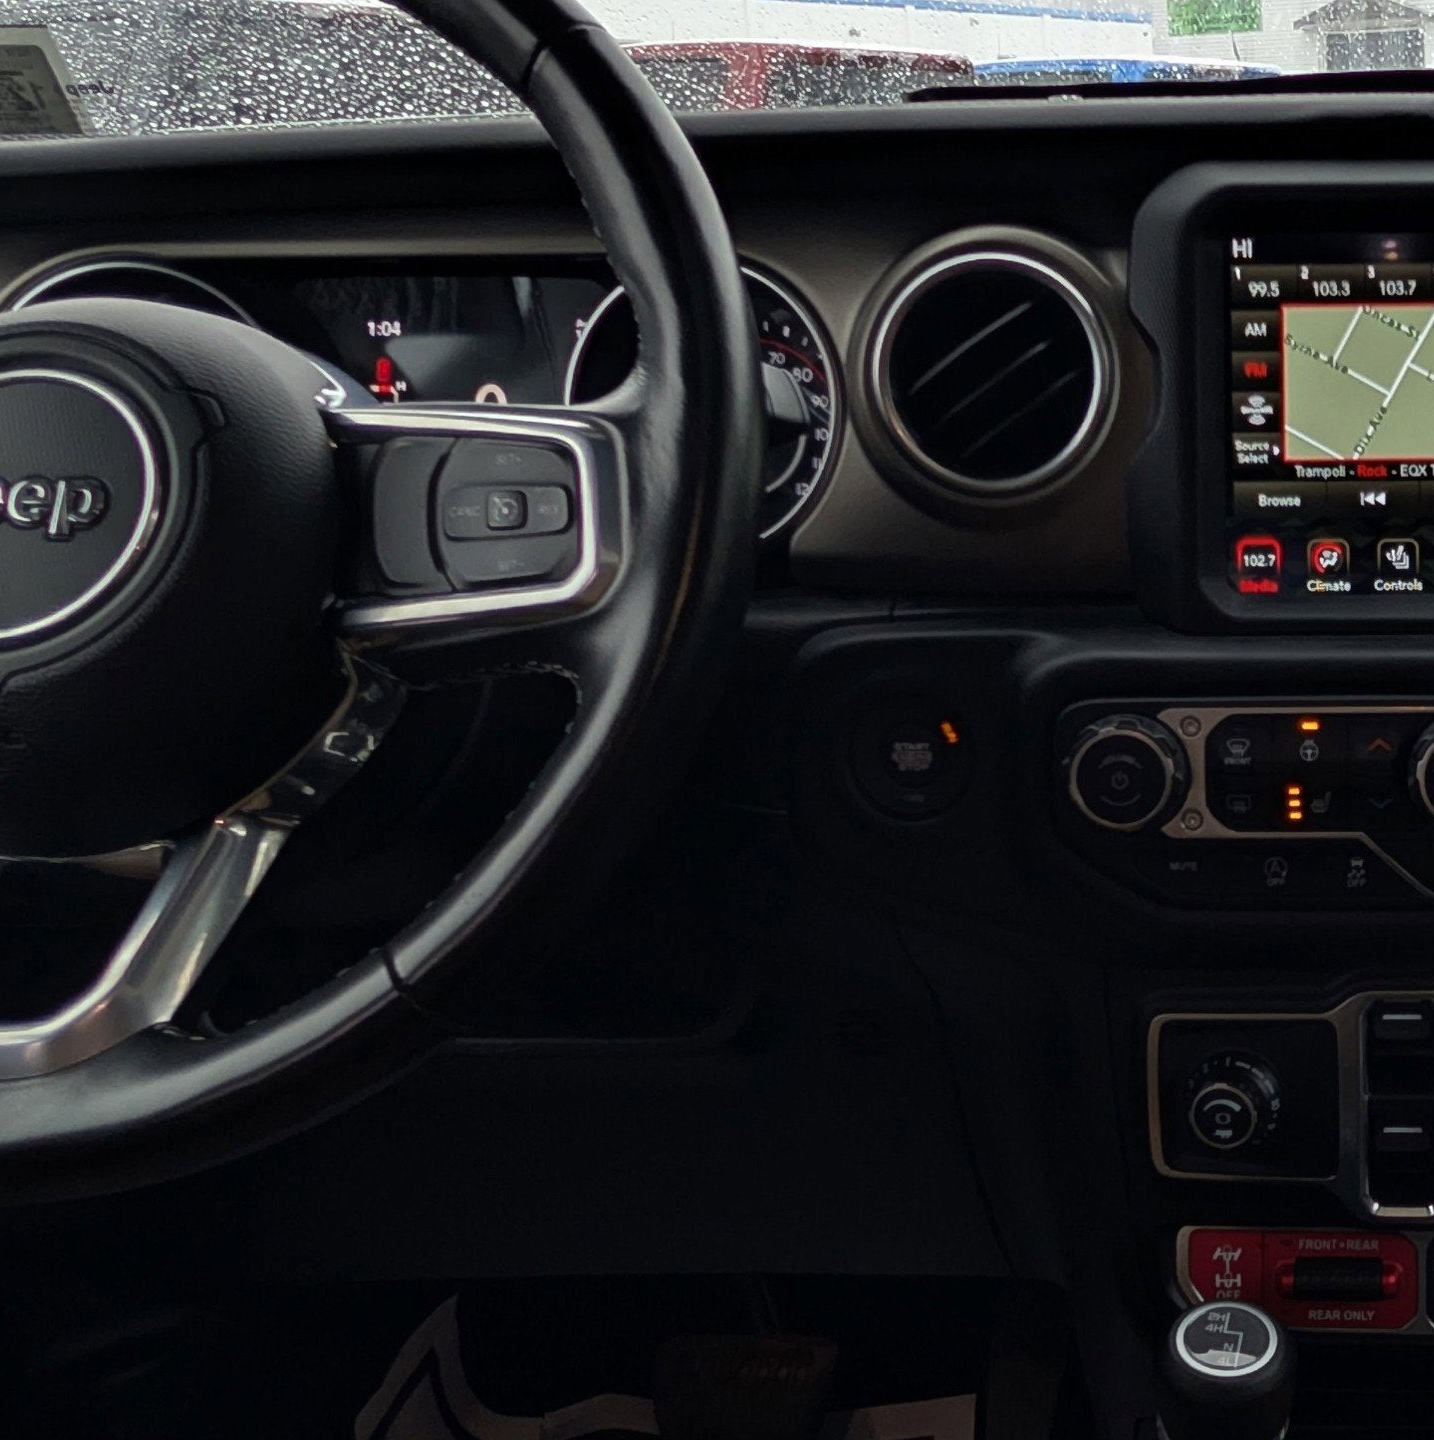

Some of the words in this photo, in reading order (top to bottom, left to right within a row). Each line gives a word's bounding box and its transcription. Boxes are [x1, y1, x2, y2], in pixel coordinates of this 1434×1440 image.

[1232, 238, 1253, 258] HI
[1248, 281, 1280, 297] 99.5
[1313, 280, 1350, 297] 103.3
[1379, 279, 1416, 296] 103.7
[367, 320, 401, 337] 1:04
[1245, 322, 1267, 337] AM
[1244, 362, 1268, 378] FM
[1357, 464, 1387, 477] Rock
[1400, 464, 1426, 477] EQX
[1258, 494, 1301, 507] Browse
[1244, 554, 1275, 567] 102.7
[1307, 578, 1351, 592] Climate
[1374, 578, 1423, 592] Controls
[1308, 1310, 1341, 1321] REAR
[1343, 1310, 1375, 1322] ONLY
[1205, 1323, 1226, 1333] 4H
[1223, 1342, 1233, 1351] N
